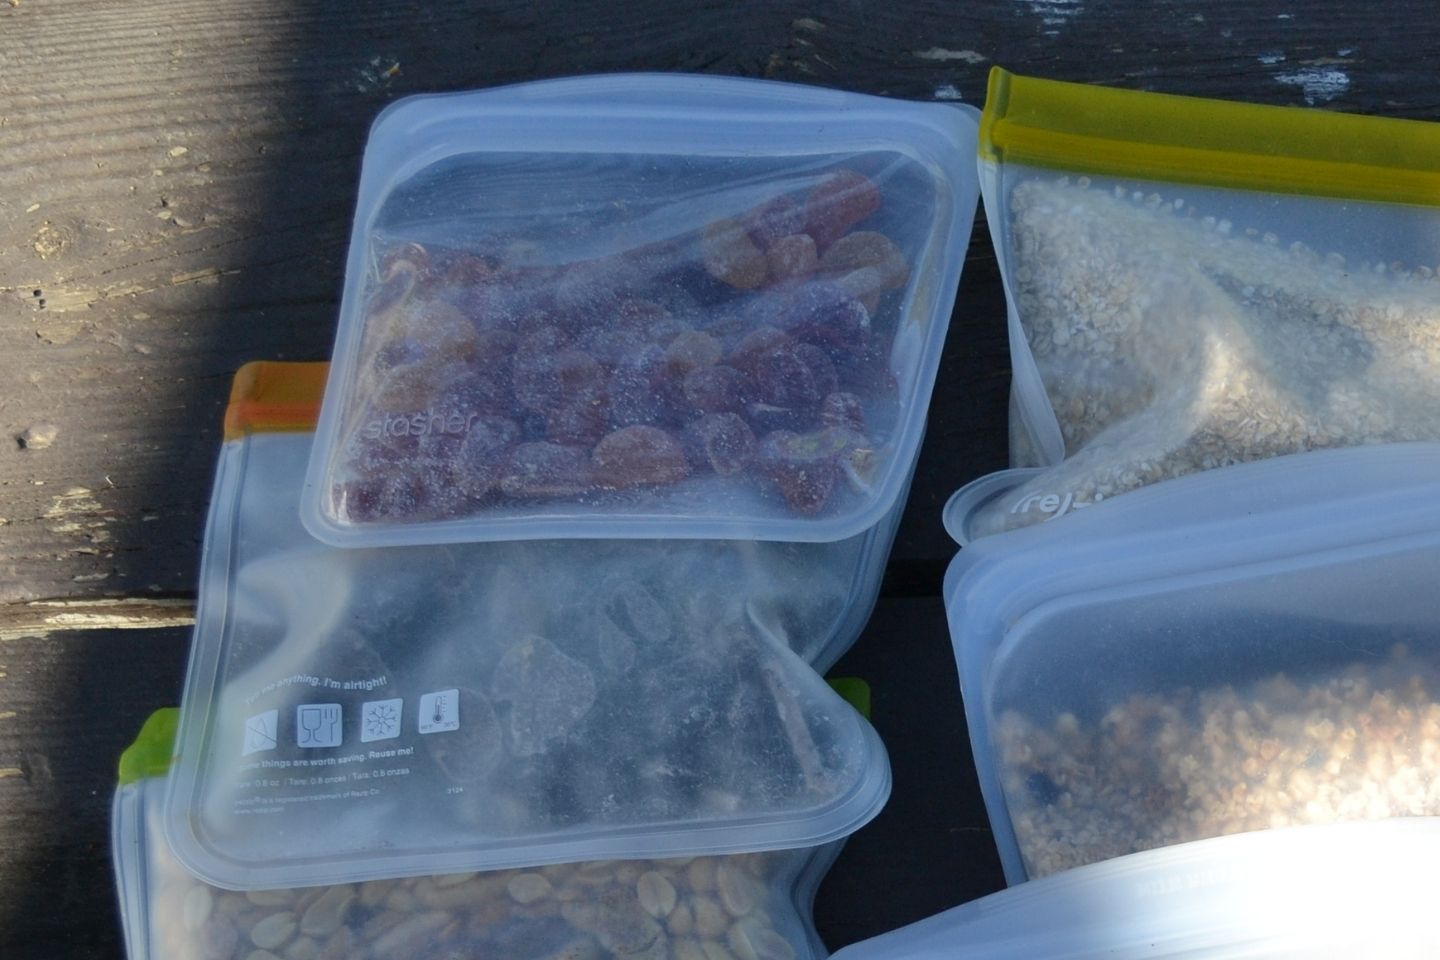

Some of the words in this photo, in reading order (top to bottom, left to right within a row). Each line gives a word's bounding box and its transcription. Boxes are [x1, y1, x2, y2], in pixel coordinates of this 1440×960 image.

[363, 407, 478, 439] stasher
[277, 674, 322, 691] anything.
[324, 677, 341, 689] I'm
[343, 676, 387, 691] airtight!
[262, 760, 291, 769] things
[293, 759, 309, 767] are
[310, 757, 336, 766] worth
[338, 754, 367, 763] saving.
[369, 750, 396, 759] Reuse
[397, 747, 414, 757] me!
[387, 767, 410, 776] onzas
